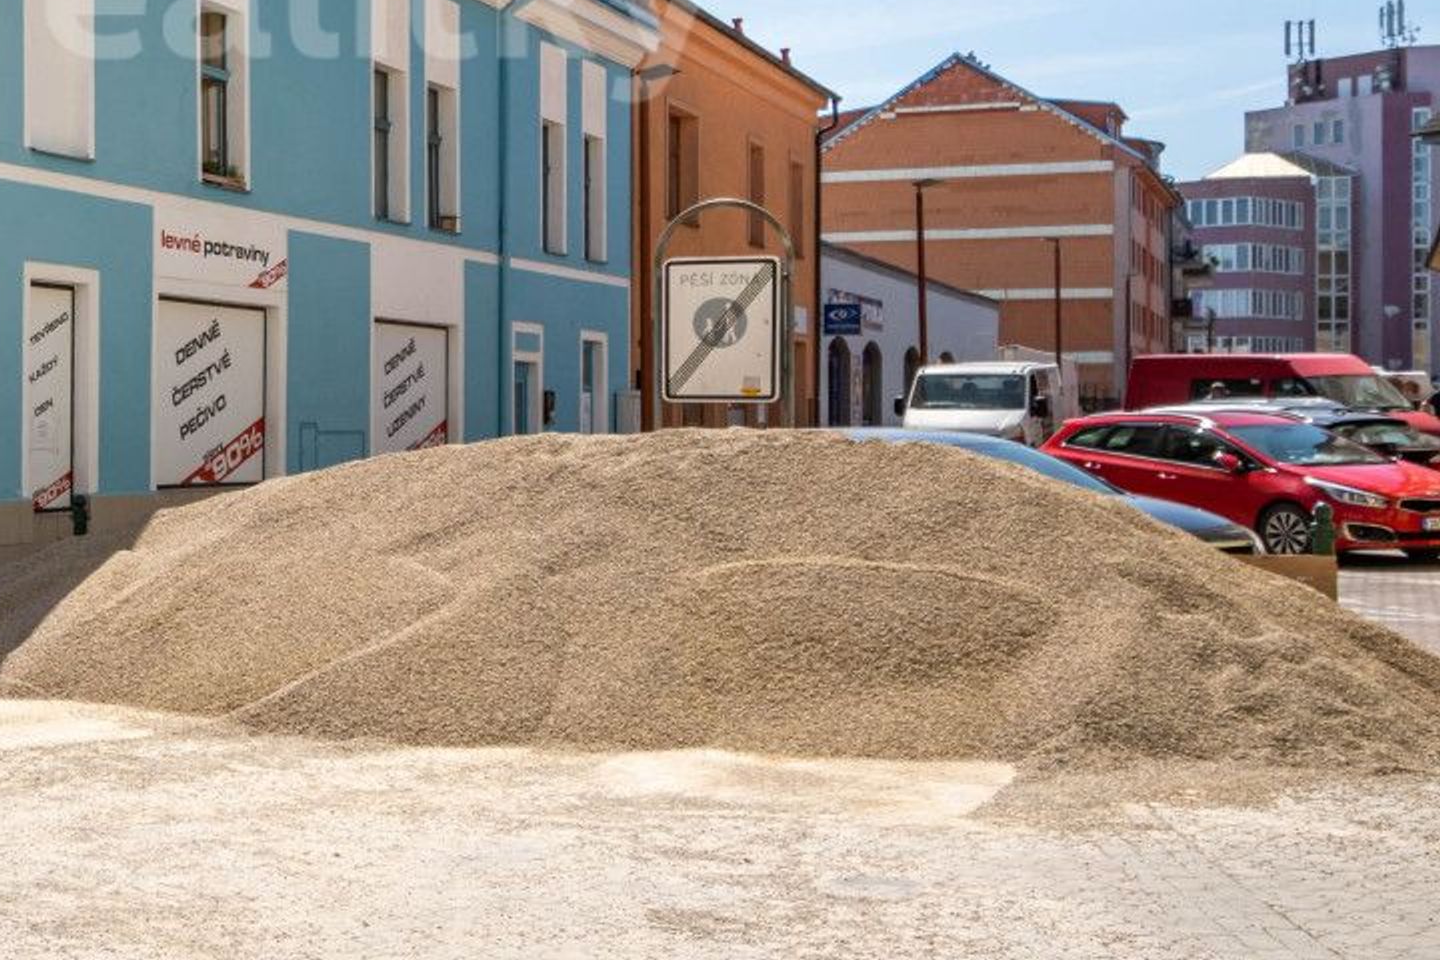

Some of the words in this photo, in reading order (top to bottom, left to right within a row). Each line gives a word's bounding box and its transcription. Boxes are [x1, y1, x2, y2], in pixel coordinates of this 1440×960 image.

[161, 229, 201, 253] levné
[204, 240, 269, 267] potraviny
[172, 347, 232, 407] ČERSTVÉ
[179, 394, 227, 441] PEČIVO
